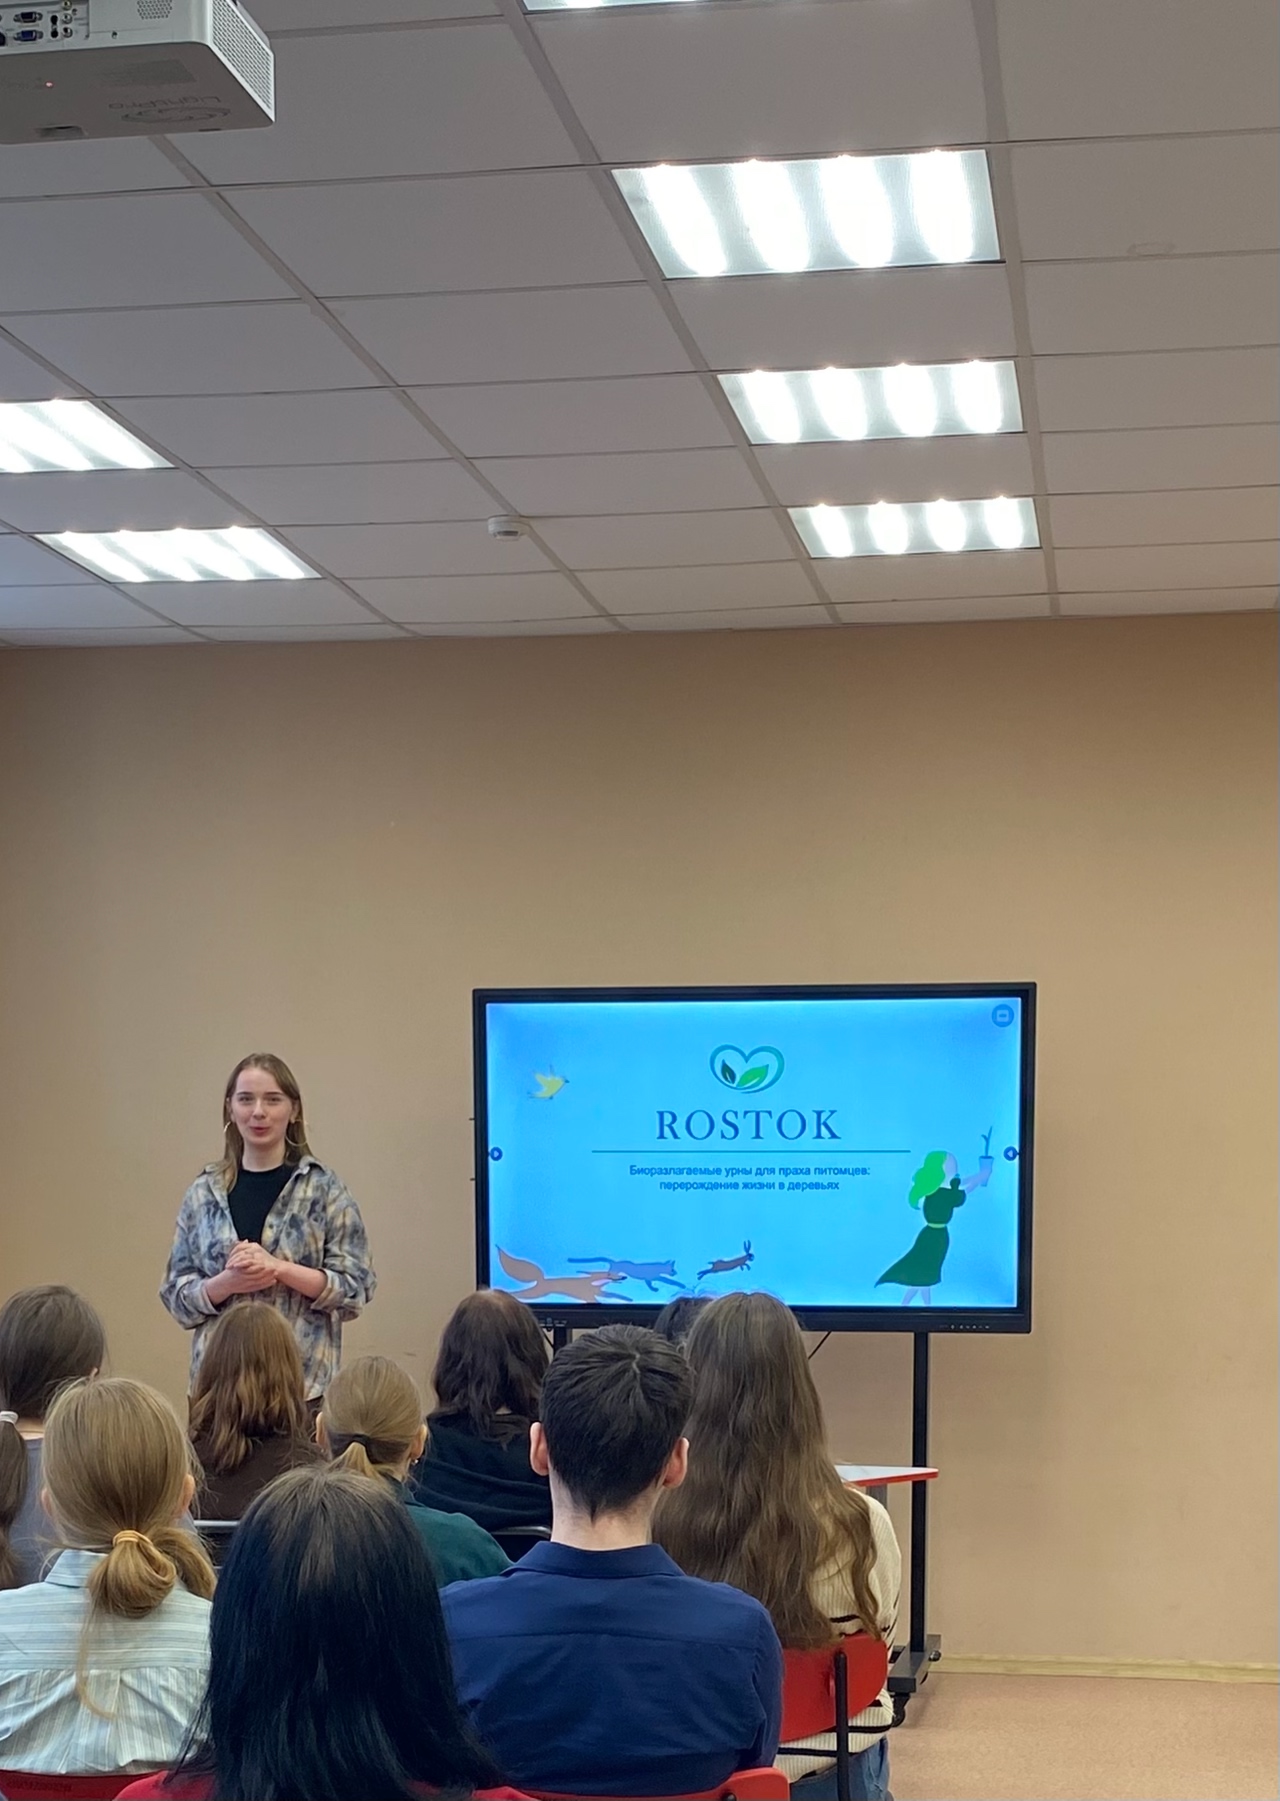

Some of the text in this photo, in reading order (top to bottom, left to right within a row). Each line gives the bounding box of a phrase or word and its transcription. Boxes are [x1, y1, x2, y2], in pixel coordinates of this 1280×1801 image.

[656, 1109, 842, 1140] ROSTOK
[629, 1164, 871, 1177] Биоразлагаемые урны для праха питомцев:
[659, 1181, 840, 1192] перерождение жизни в деревьях
